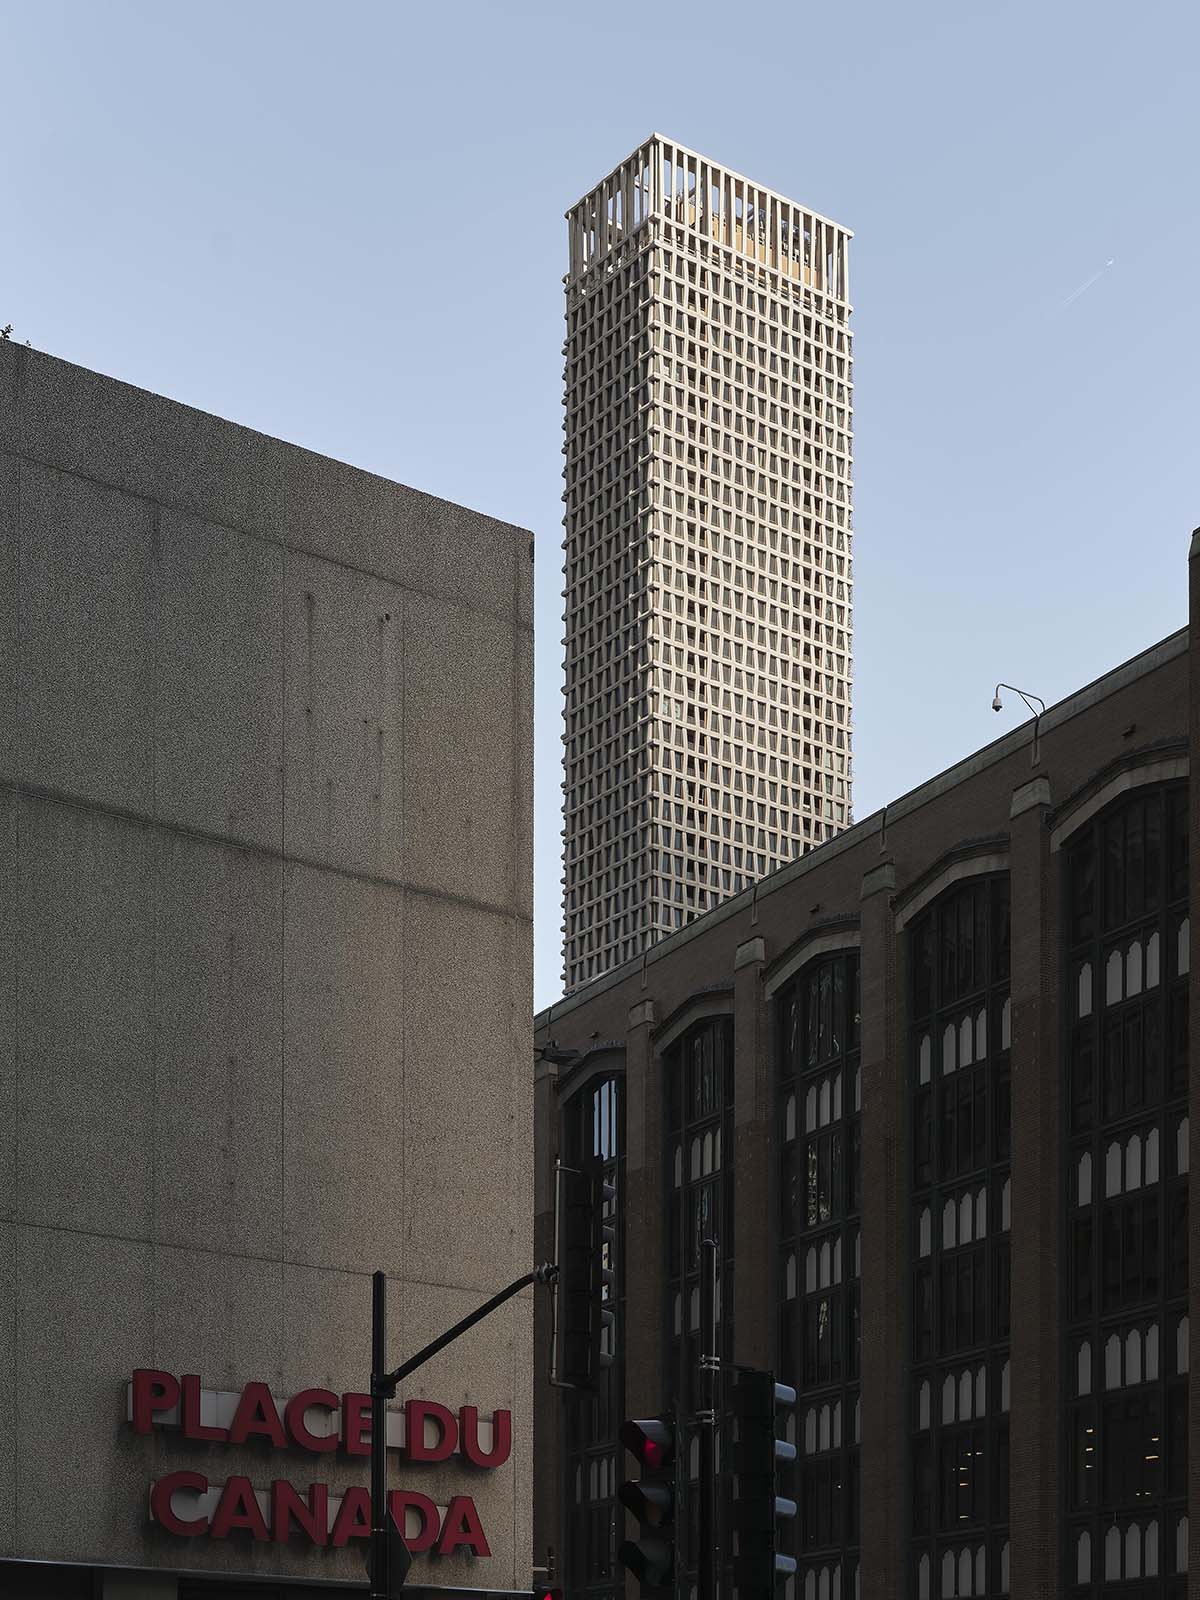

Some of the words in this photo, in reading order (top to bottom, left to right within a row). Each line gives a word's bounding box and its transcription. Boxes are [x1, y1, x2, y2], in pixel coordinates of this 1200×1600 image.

[132, 1369, 374, 1456] PLACE
[405, 1400, 512, 1468] DU
[151, 1471, 492, 1557] CANADA
